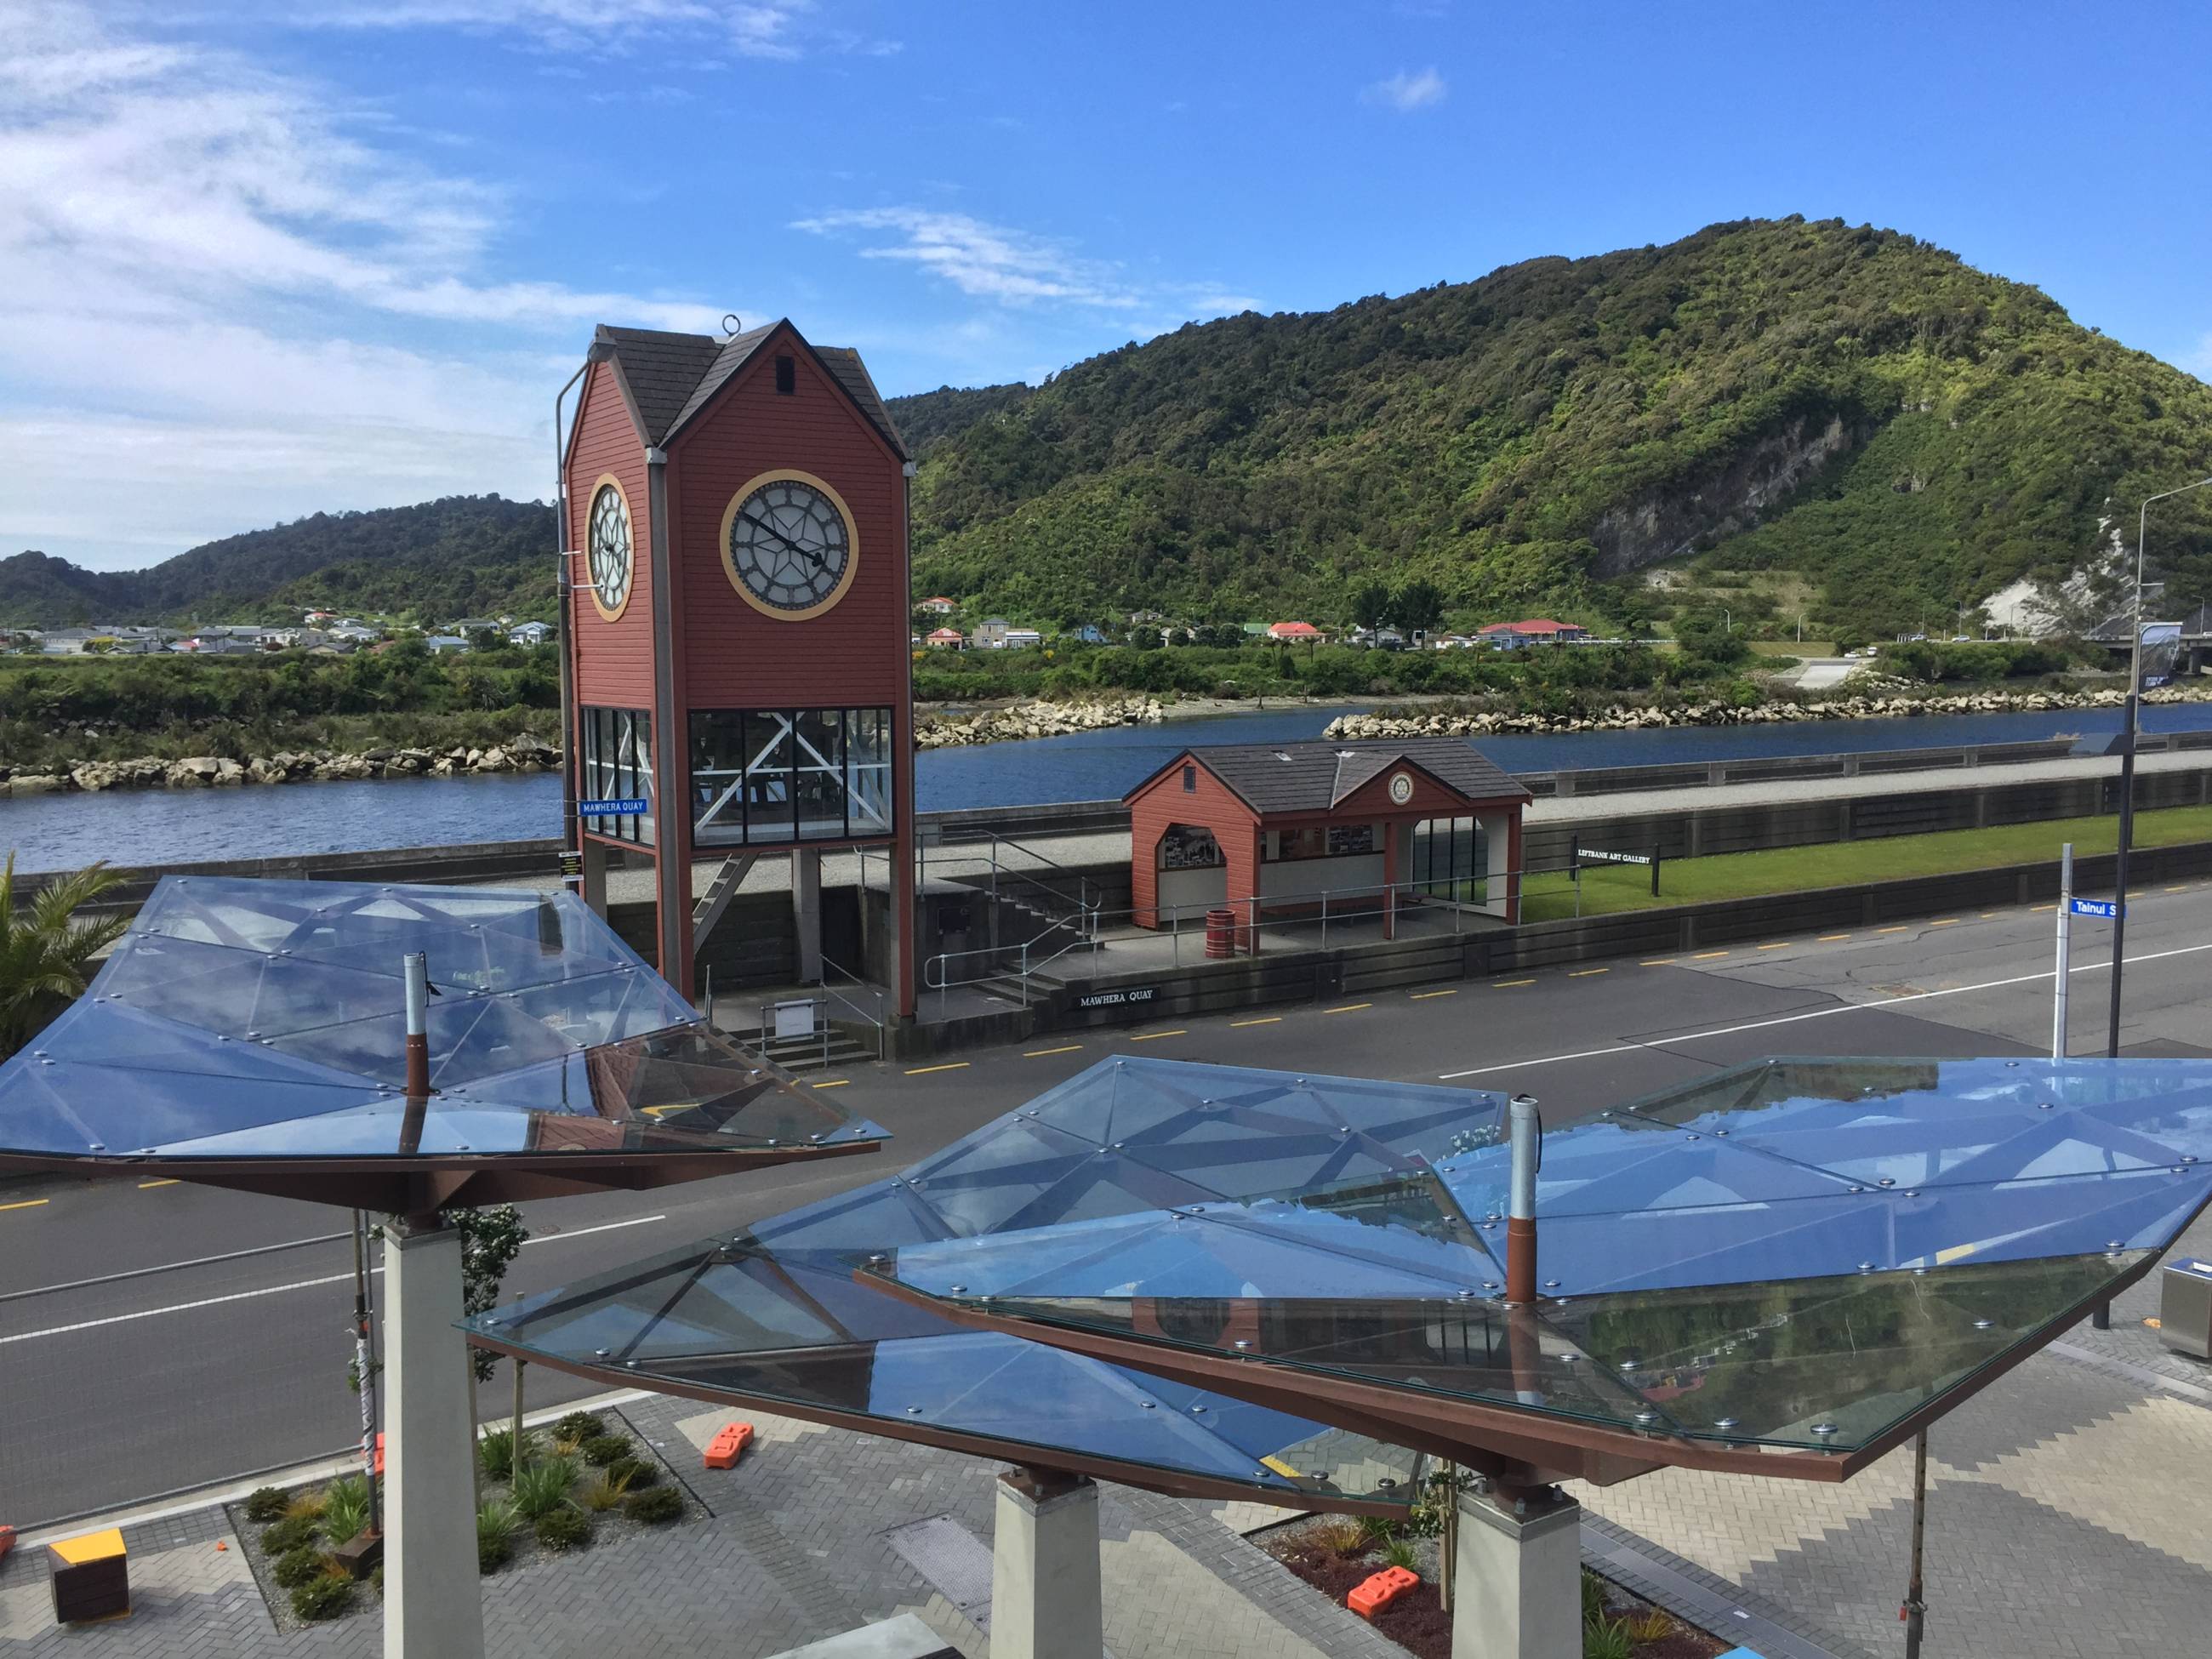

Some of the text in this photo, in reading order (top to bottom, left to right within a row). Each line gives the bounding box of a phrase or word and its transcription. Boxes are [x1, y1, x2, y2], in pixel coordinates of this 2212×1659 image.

[584, 801, 643, 812] MAWHERA QUAY
[1577, 848, 1650, 864] LEFTBANK ART GALLERY
[2076, 901, 2106, 915] Tainui
[1080, 989, 1153, 1007] MAWHERA QUAY
